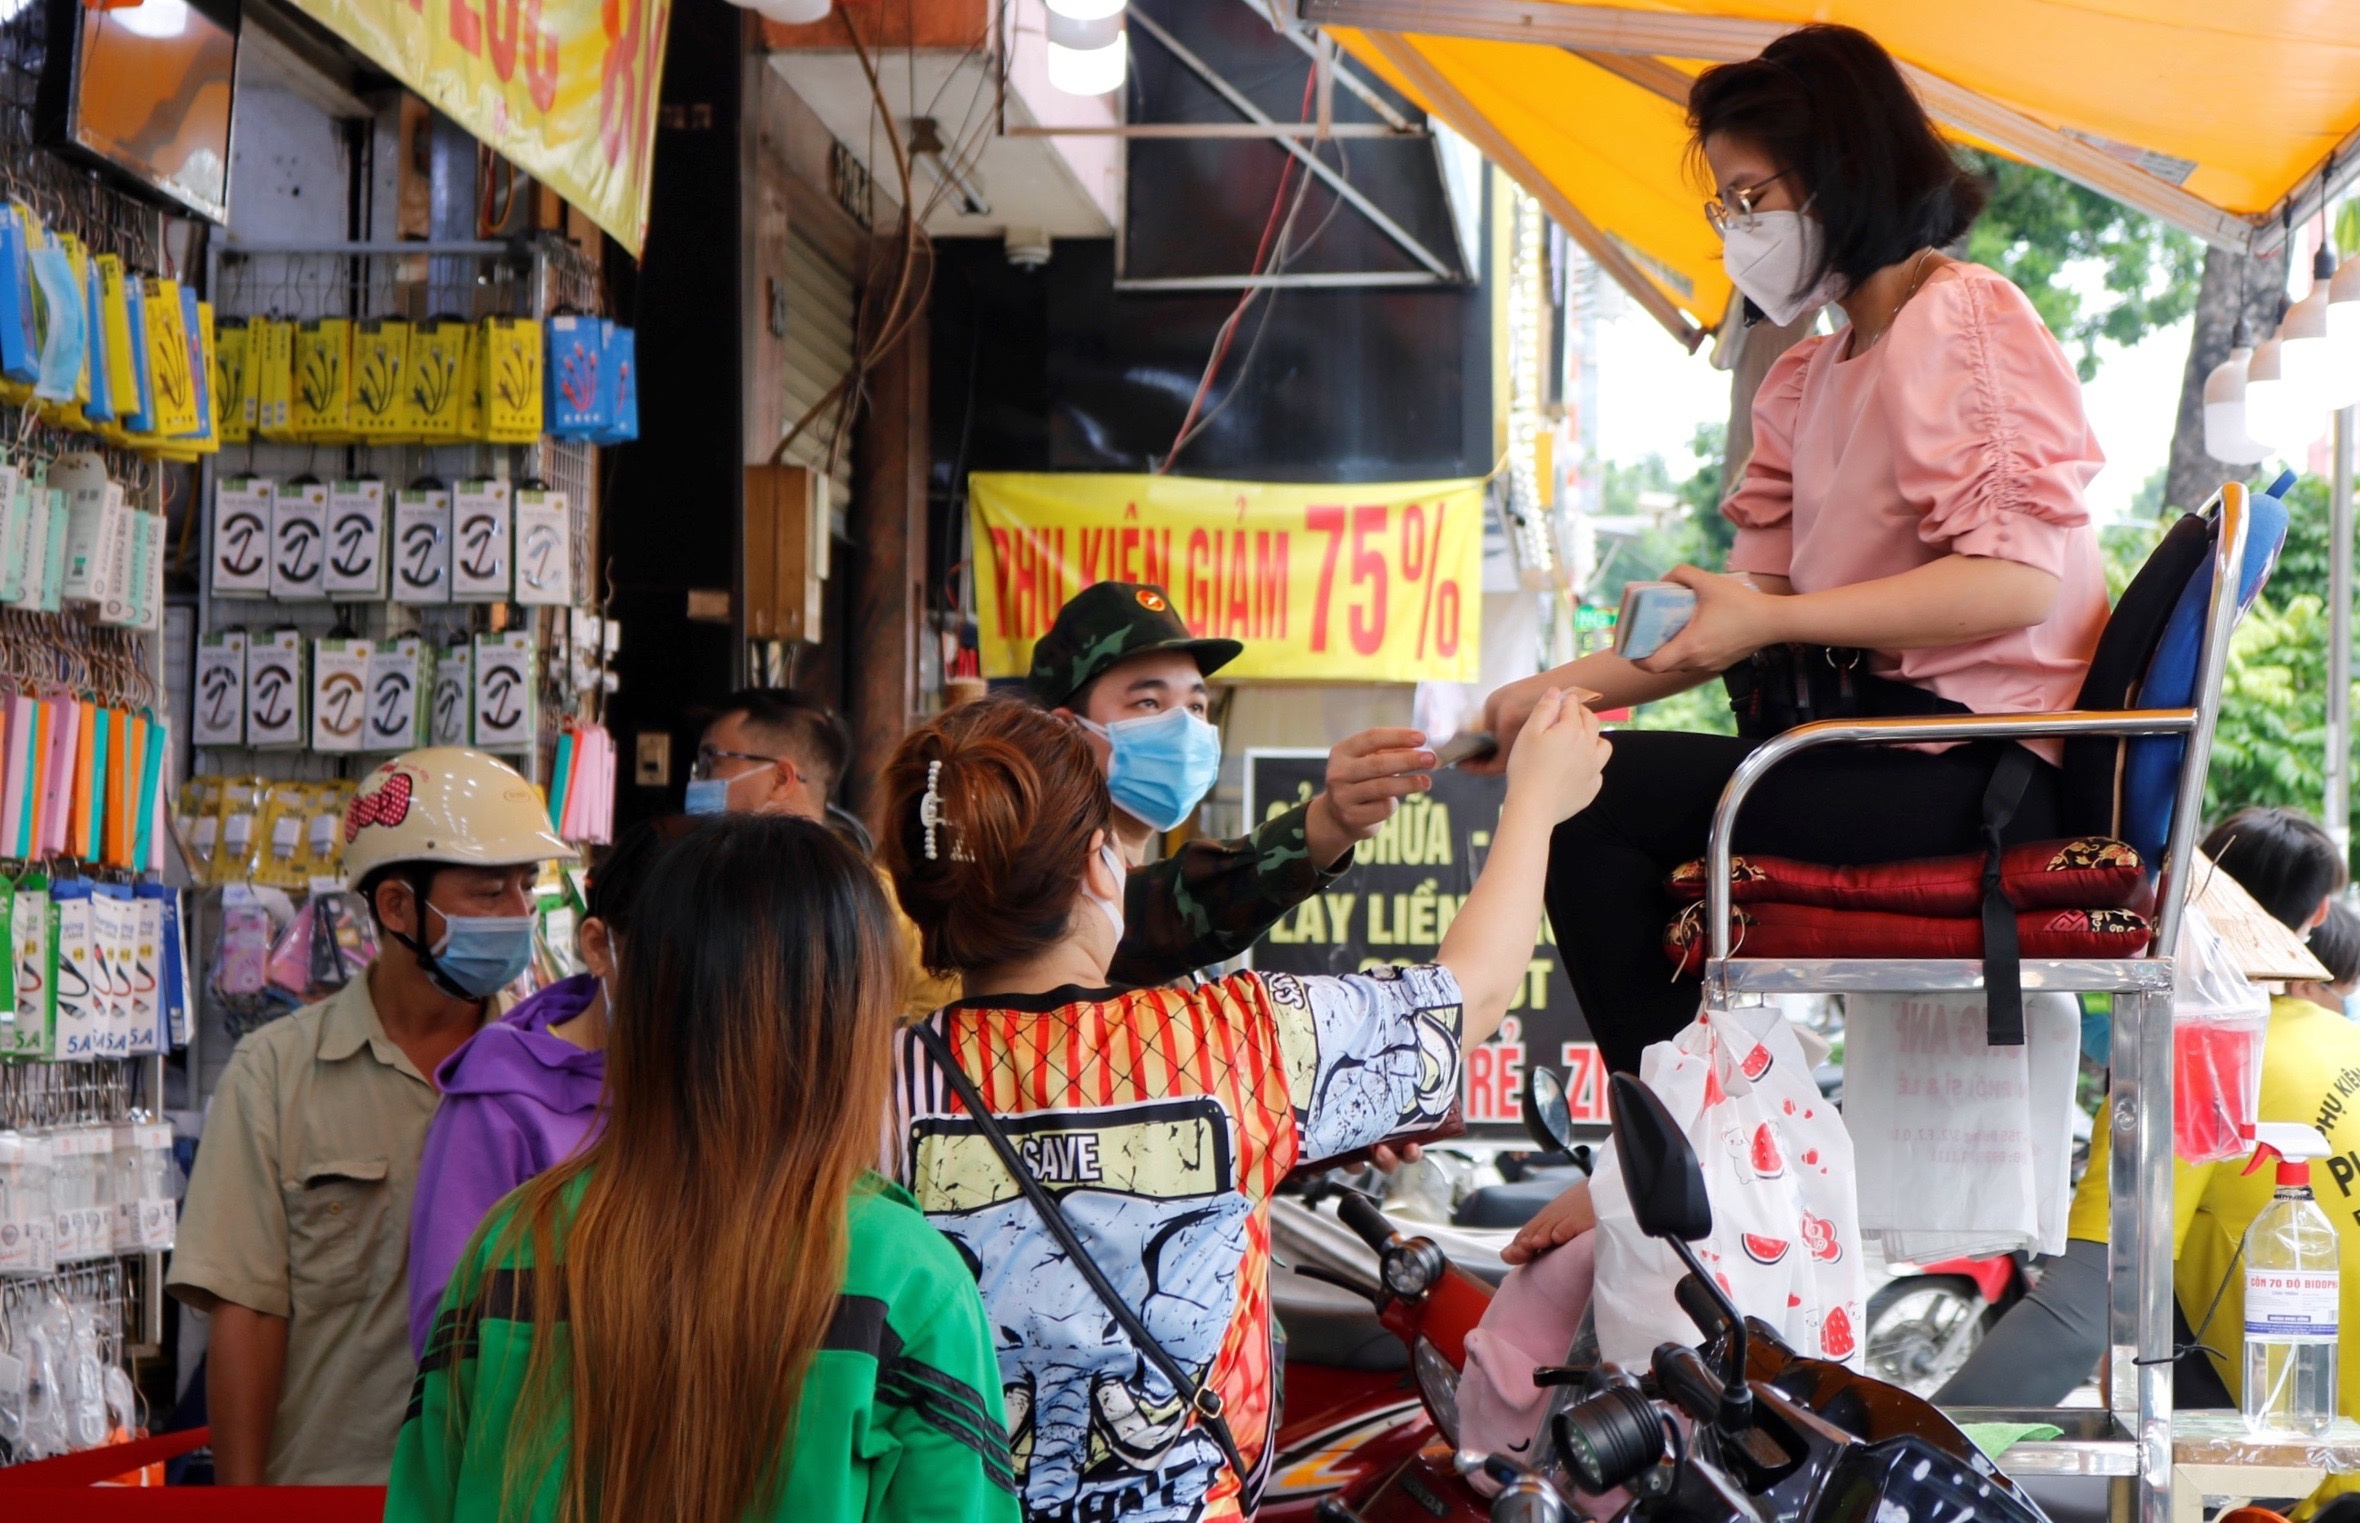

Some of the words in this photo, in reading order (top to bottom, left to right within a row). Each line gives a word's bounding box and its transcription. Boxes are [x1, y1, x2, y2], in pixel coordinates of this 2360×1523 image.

[1186, 496, 1290, 640] GIẢM
[1306, 502, 1459, 659] 75%
[67, 1032, 91, 1053] 5A
[129, 1027, 152, 1045] 5A
[1022, 1134, 1101, 1181] SAVE
[2269, 1279, 2282, 1288] 70
